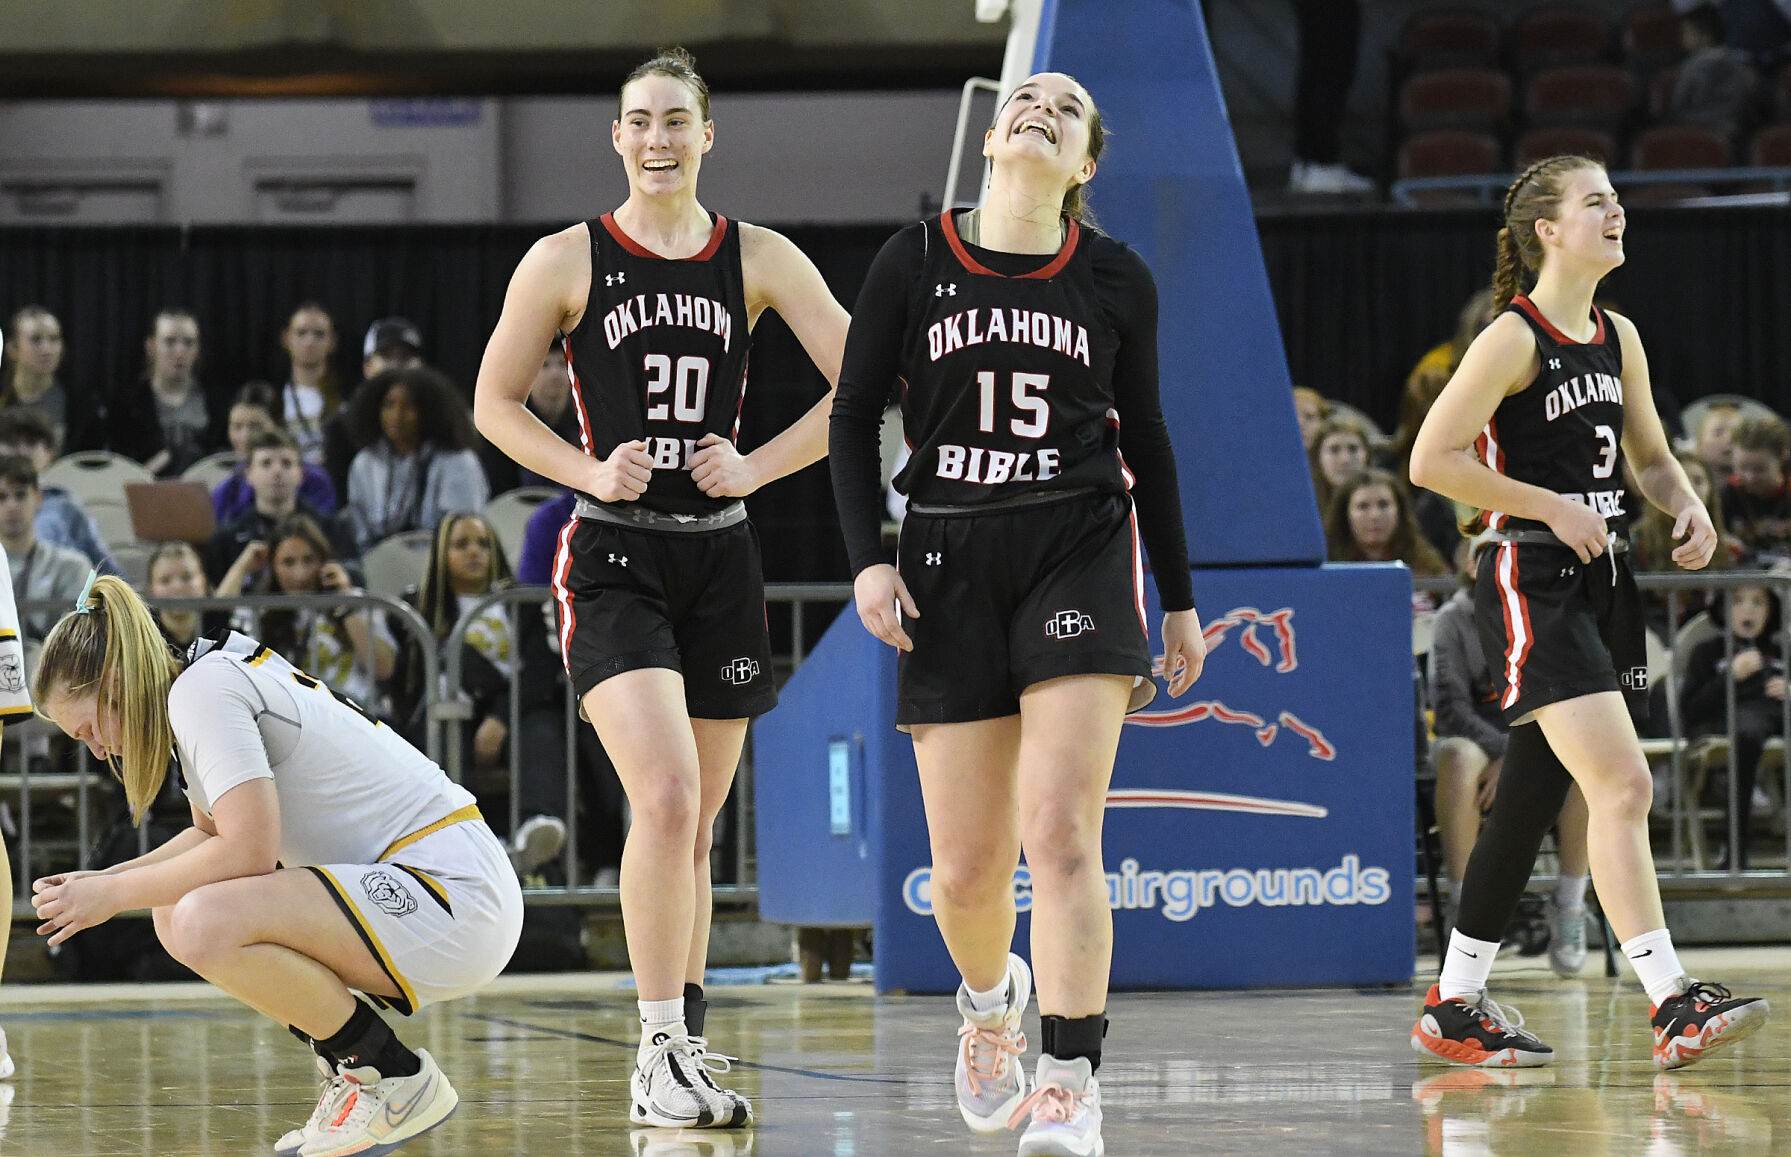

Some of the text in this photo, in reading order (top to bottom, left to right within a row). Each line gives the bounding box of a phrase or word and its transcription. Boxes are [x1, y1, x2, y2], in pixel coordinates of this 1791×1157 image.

[603, 293, 731, 355] OKLAHOM
[927, 308, 1091, 367] OKLAHOMA
[643, 353, 710, 423] 20
[977, 370, 1050, 439] 15
[935, 444, 1061, 484] BIBLE
[1592, 424, 1617, 479] 3
[1102, 853, 1391, 922] irgrounds
